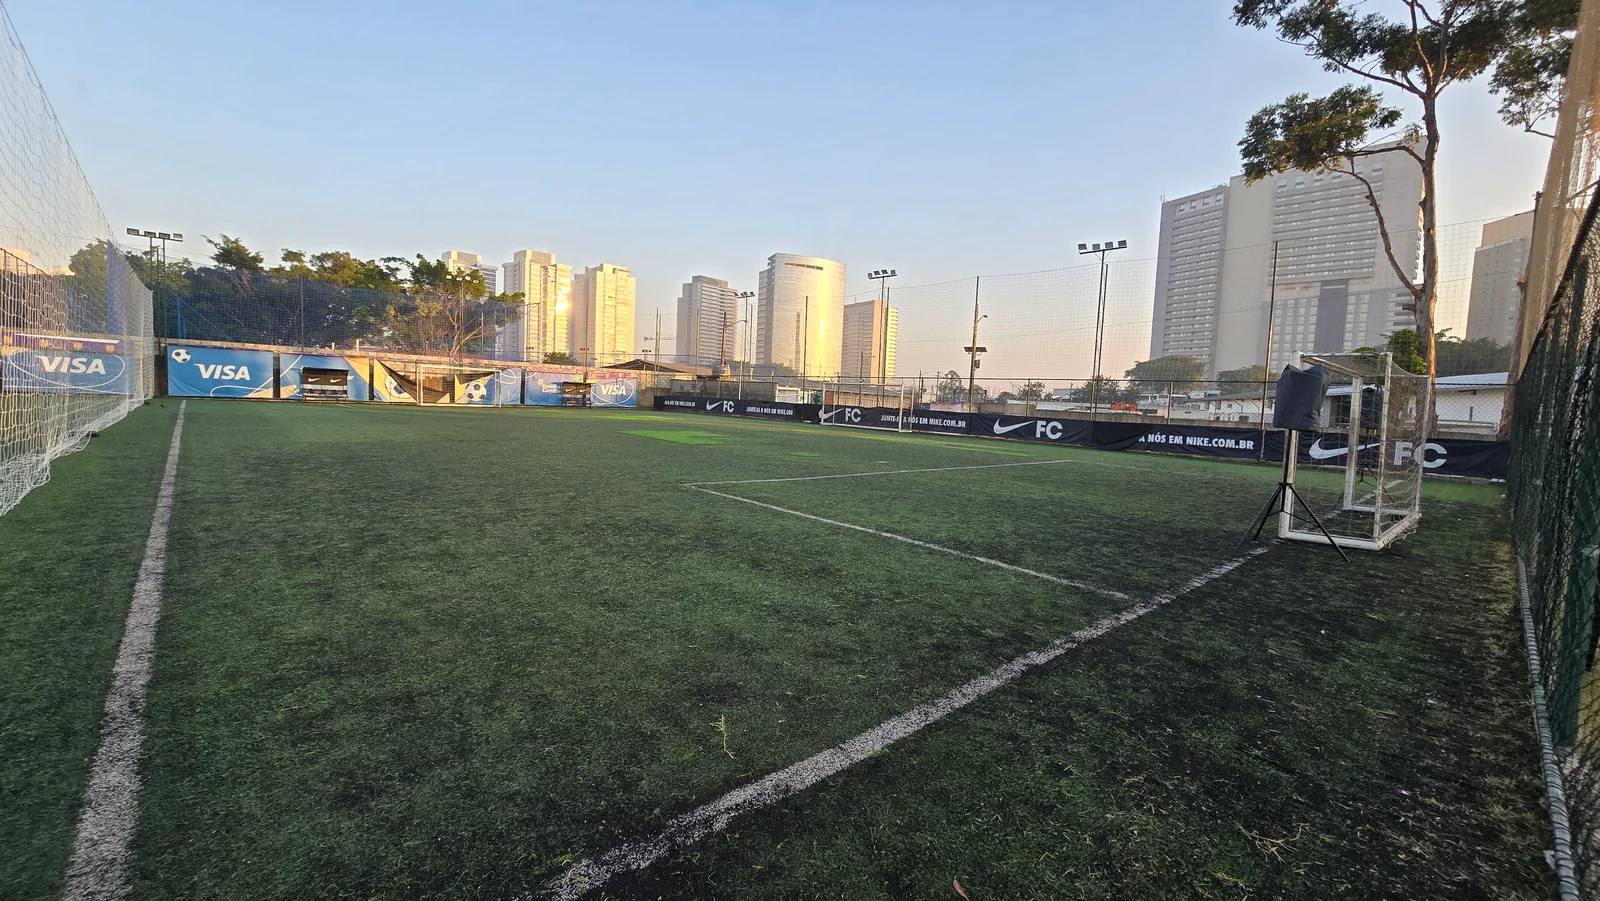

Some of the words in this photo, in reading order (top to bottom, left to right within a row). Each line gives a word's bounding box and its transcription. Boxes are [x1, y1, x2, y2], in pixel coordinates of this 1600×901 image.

[35, 355, 106, 375] VISA
[193, 363, 251, 381] VISA
[600, 384, 627, 396] VISA
[722, 400, 735, 413] FC
[845, 407, 862, 423] FC
[881, 415, 902, 423] JUNTE-S
[919, 417, 928, 425] EM
[929, 418, 966, 428] NIKE.COM.BR
[1035, 420, 1063, 440] FC
[1147, 432, 1166, 443] NÓS
[1168, 435, 1183, 445] EM
[1186, 436, 1254, 450] NIKE.COM.BR
[1394, 441, 1447, 468] FC
